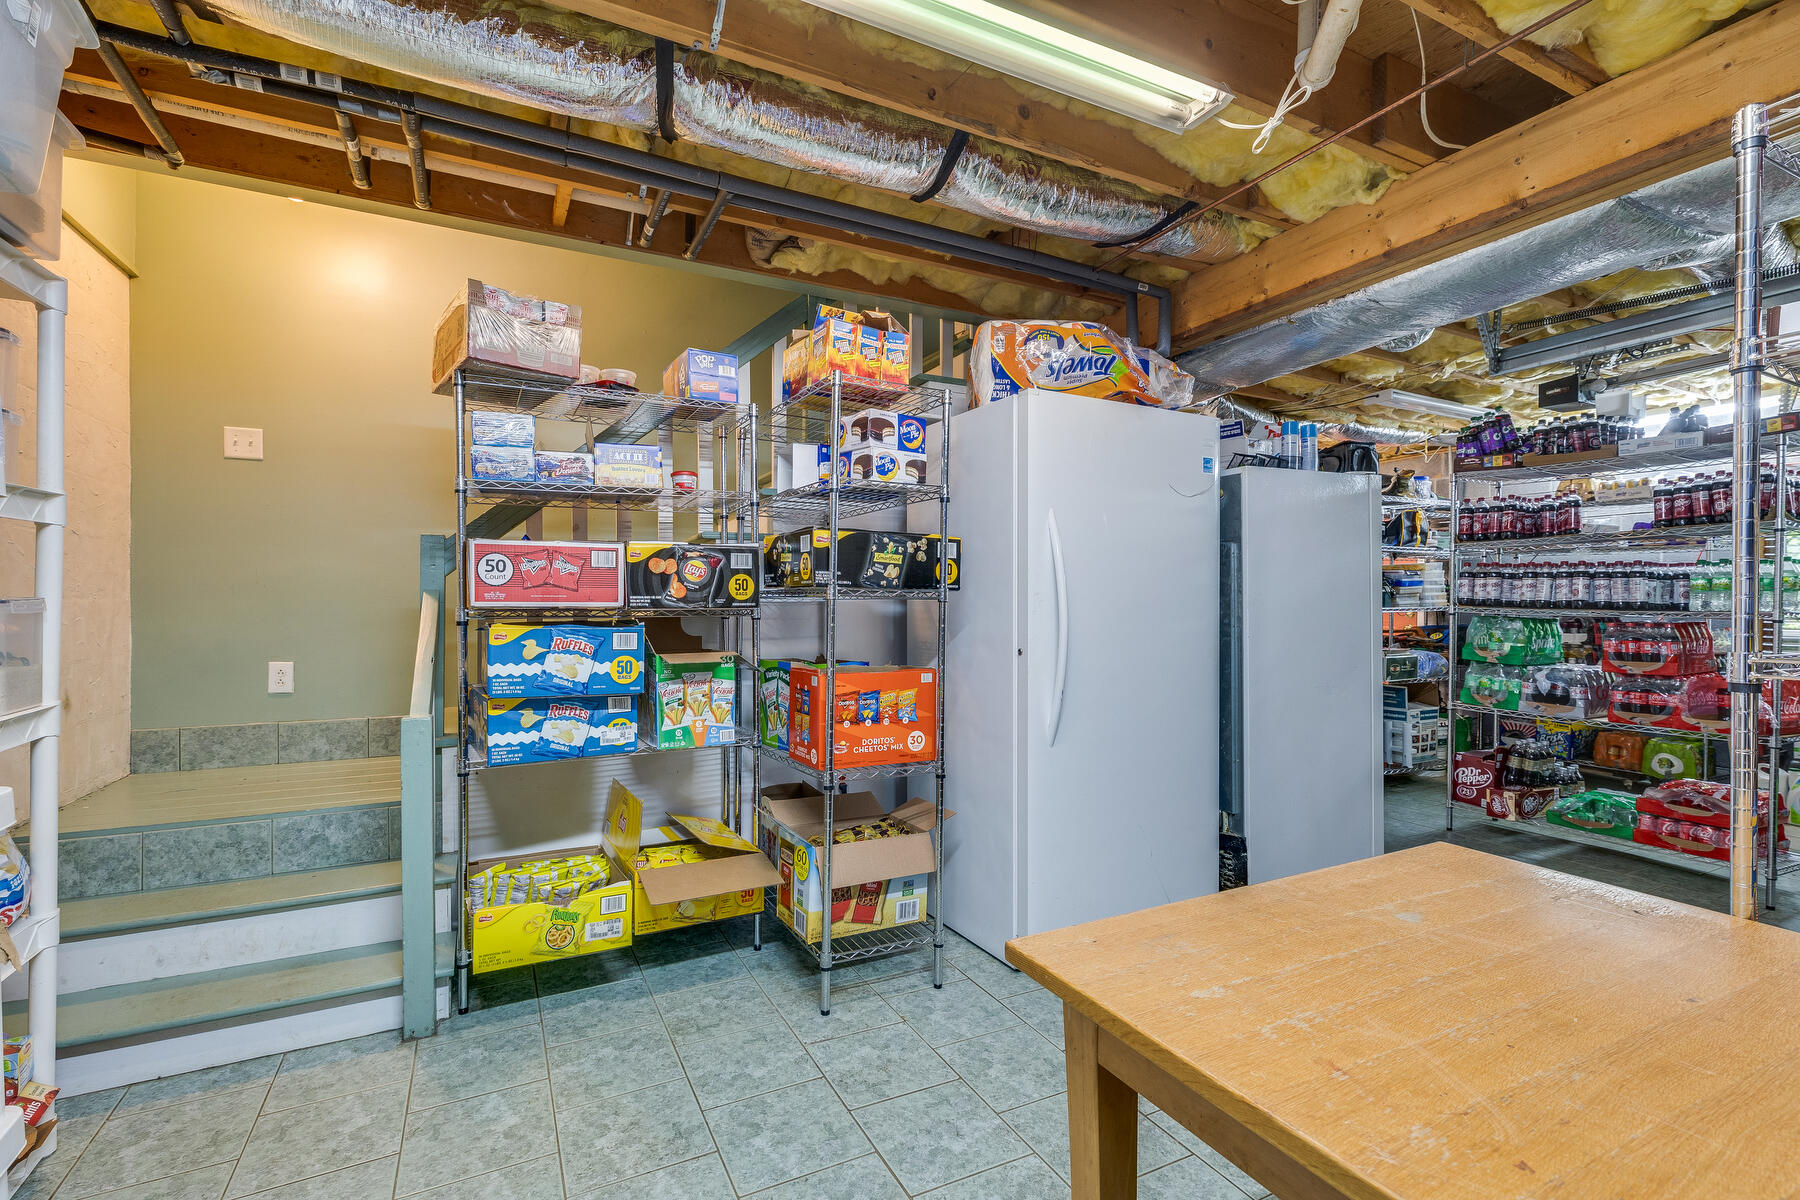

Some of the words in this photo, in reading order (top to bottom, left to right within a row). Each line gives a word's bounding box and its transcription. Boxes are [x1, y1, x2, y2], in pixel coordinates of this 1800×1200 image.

[1045, 355, 1117, 382] Towels
[900, 424, 916, 434] Moon
[910, 430, 920, 439] Pie
[613, 452, 627, 460] ACT
[874, 457, 891, 466] Moon
[885, 462, 895, 471] Pie
[876, 554, 901, 562] Smartfood
[484, 559, 507, 573] 50
[734, 578, 748, 591] 50
[553, 637, 595, 656] RUFFLES
[1531, 637, 1556, 650] Sprite
[616, 659, 633, 675] 50
[548, 704, 589, 721] RUFFLES
[862, 737, 894, 746] DORITOS
[910, 735, 923, 745] 30
[1539, 732, 1565, 743] Brisk
[853, 744, 888, 754] CHEETOS
[890, 743, 904, 751] MIX
[1458, 767, 1490, 785] Pepper
[1467, 767, 1482, 775] Dr
[796, 848, 807, 866] 60
